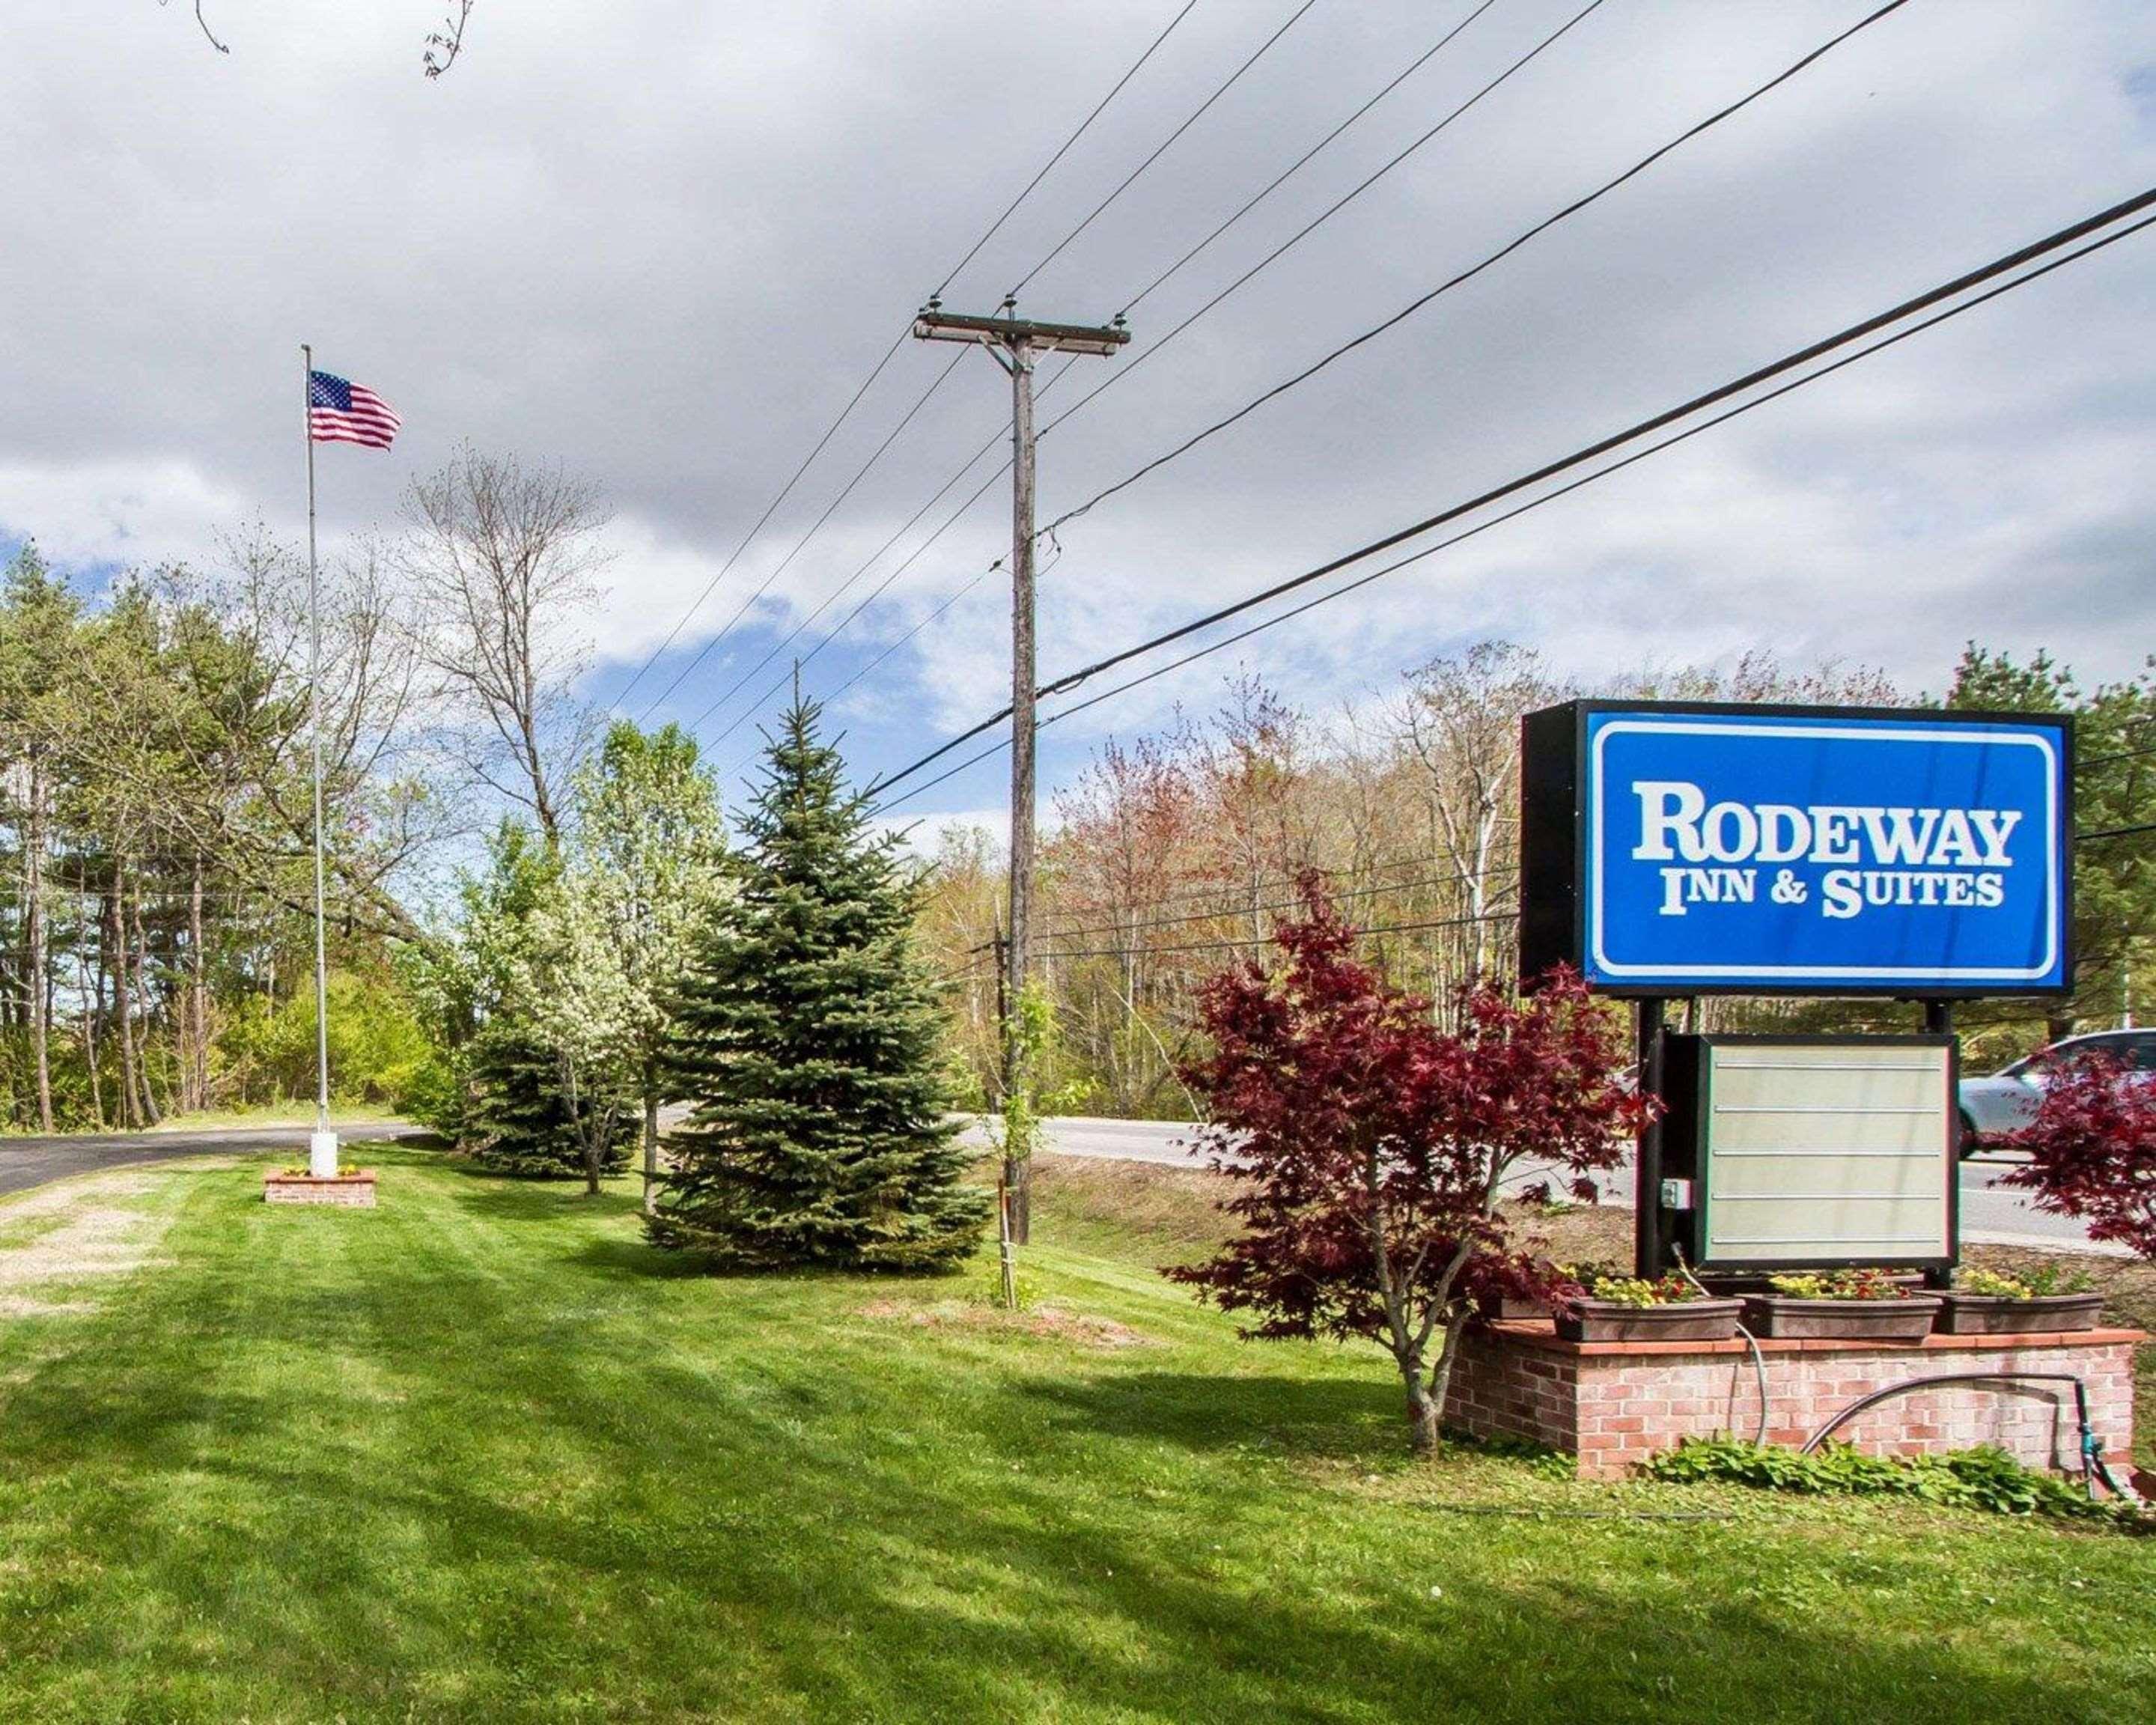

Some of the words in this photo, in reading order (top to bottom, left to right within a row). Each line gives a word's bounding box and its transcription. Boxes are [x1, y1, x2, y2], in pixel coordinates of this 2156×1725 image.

[1633, 781, 2022, 867] RODEWAY
[1660, 868, 1757, 915] INN
[1771, 869, 1807, 904] &
[1823, 869, 2004, 919] SUITES
